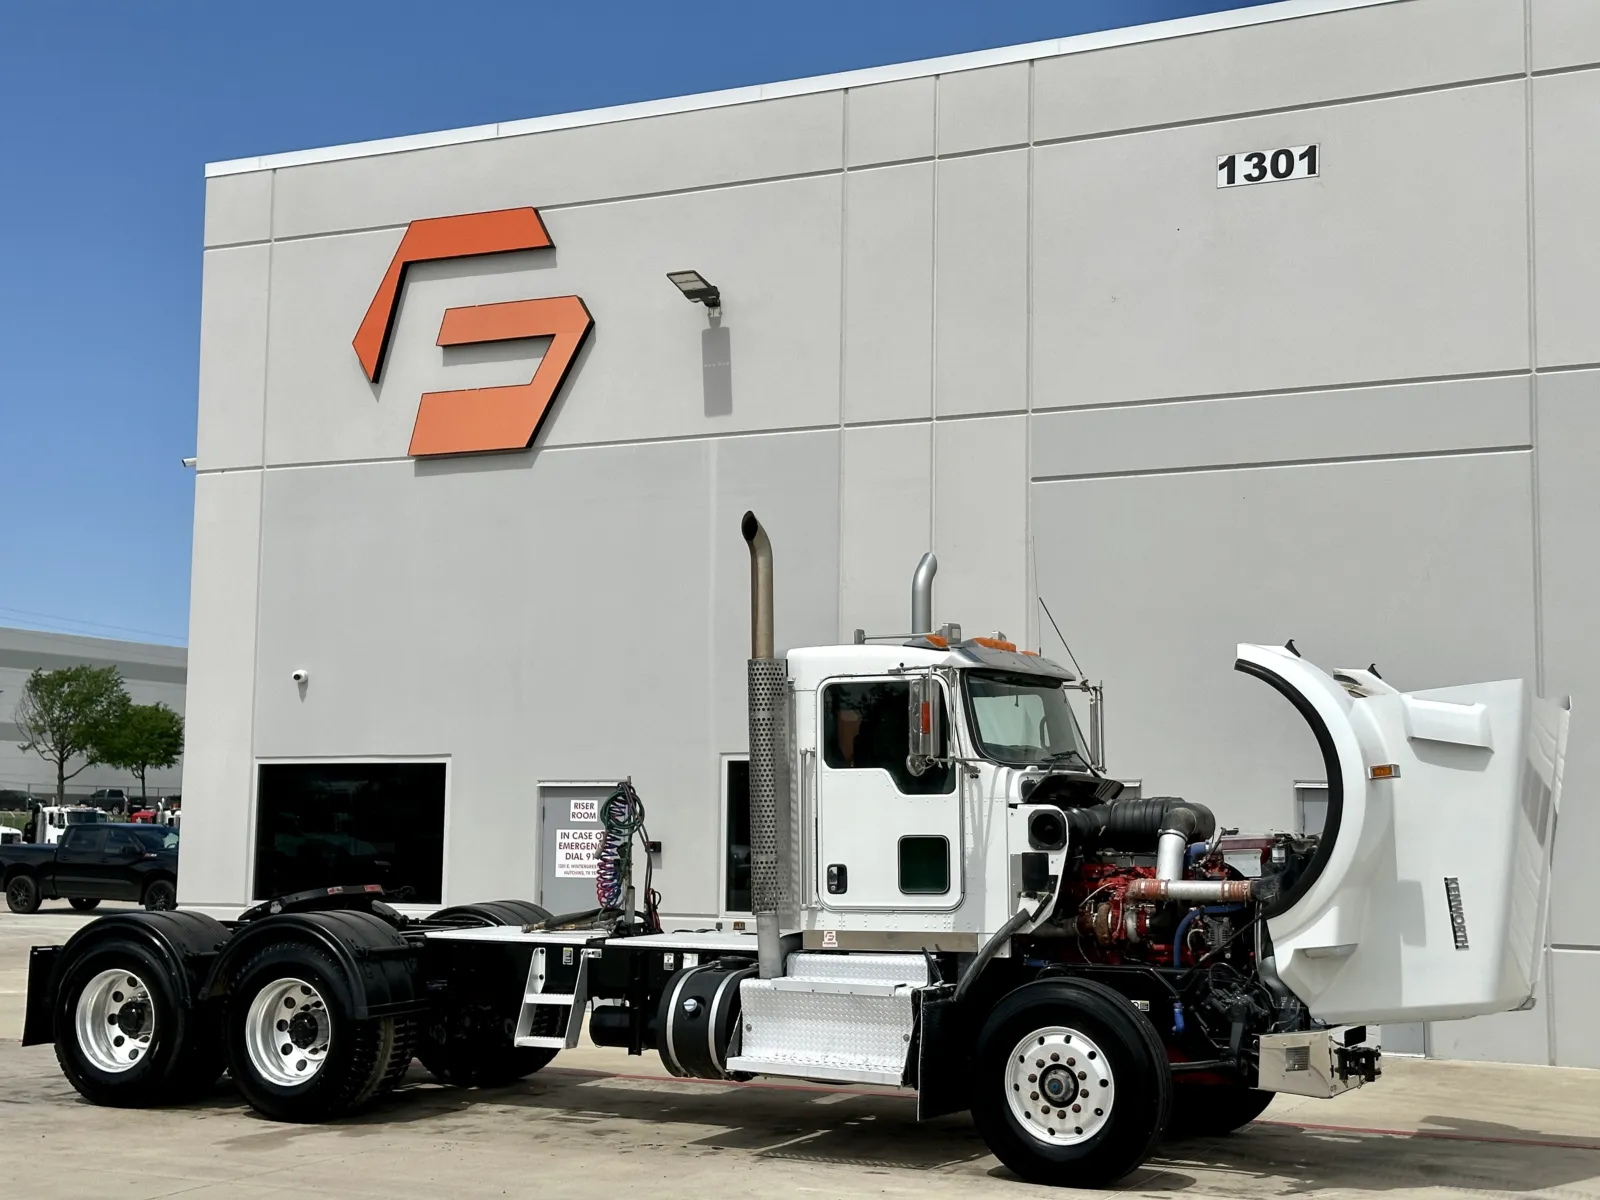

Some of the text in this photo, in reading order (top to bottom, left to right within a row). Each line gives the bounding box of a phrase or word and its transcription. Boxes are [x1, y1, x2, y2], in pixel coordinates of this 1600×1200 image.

[1218, 145, 1317, 185] 1301
[560, 832, 570, 840] IN
[572, 832, 593, 840] CASE
[558, 842, 602, 850] EMERGEN
[565, 852, 584, 860] DIAL
[1446, 877, 1469, 949] KENWORTH
